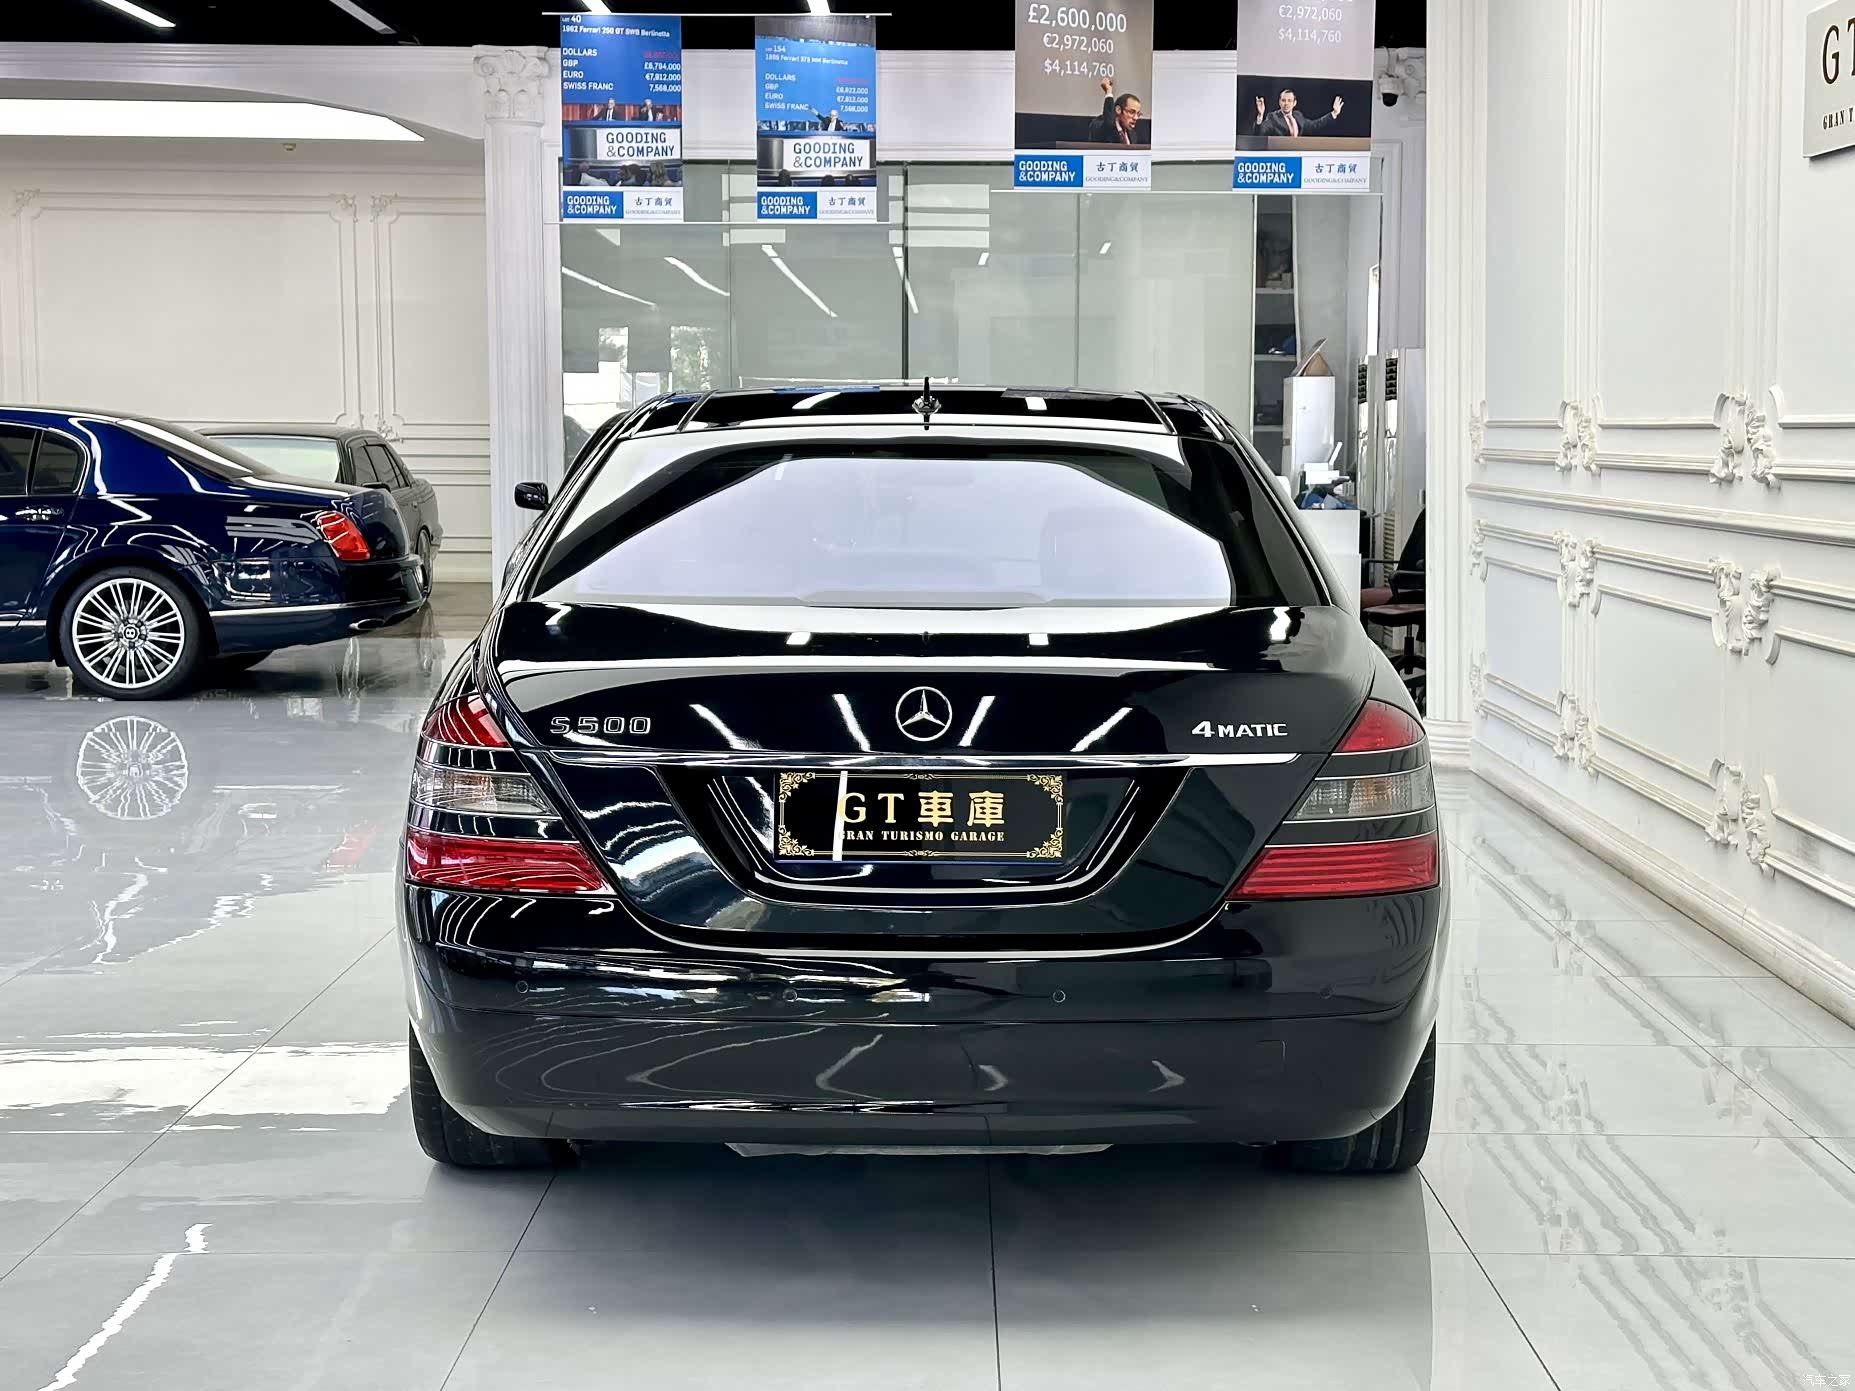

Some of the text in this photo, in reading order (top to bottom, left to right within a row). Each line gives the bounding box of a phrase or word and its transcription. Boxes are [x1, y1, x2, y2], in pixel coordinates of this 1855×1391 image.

[1028, 4, 1127, 33] £2,600,000
[1278, 5, 1342, 21] €2,972,060
[571, 15, 581, 23] 40
[579, 26, 601, 34] Ferrari
[1278, 27, 1342, 44] $4,114,760
[1043, 33, 1114, 54] €2,972,060
[562, 48, 598, 56] DOLLARS
[562, 59, 579, 67] GBP
[1044, 58, 1115, 78] $4,114,760
[563, 71, 584, 79] EURO
[765, 73, 796, 81] DOLLARS
[563, 82, 587, 90] SWISS
[588, 82, 614, 91] FRANC
[765, 92, 784, 100] EURO
[1822, 110, 1845, 130] GRAN
[606, 131, 666, 144] GOODING
[606, 145, 675, 157] &COMPANY
[793, 142, 855, 154] GOODING
[793, 156, 863, 168] &COMPANY
[1018, 160, 1068, 171] GOODING
[1237, 162, 1286, 173] GOODING
[1018, 171, 1076, 182] &COMPANY
[1237, 173, 1294, 183] &COMPANY
[567, 195, 610, 205] GOODING
[761, 196, 804, 206] GOODING
[567, 205, 617, 214] &COMPANY
[761, 206, 811, 215] &COMPANY
[839, 790, 1005, 828] GT 車庫
[881, 830, 944, 842] TURISMO
[951, 830, 1005, 842] GARAGE
